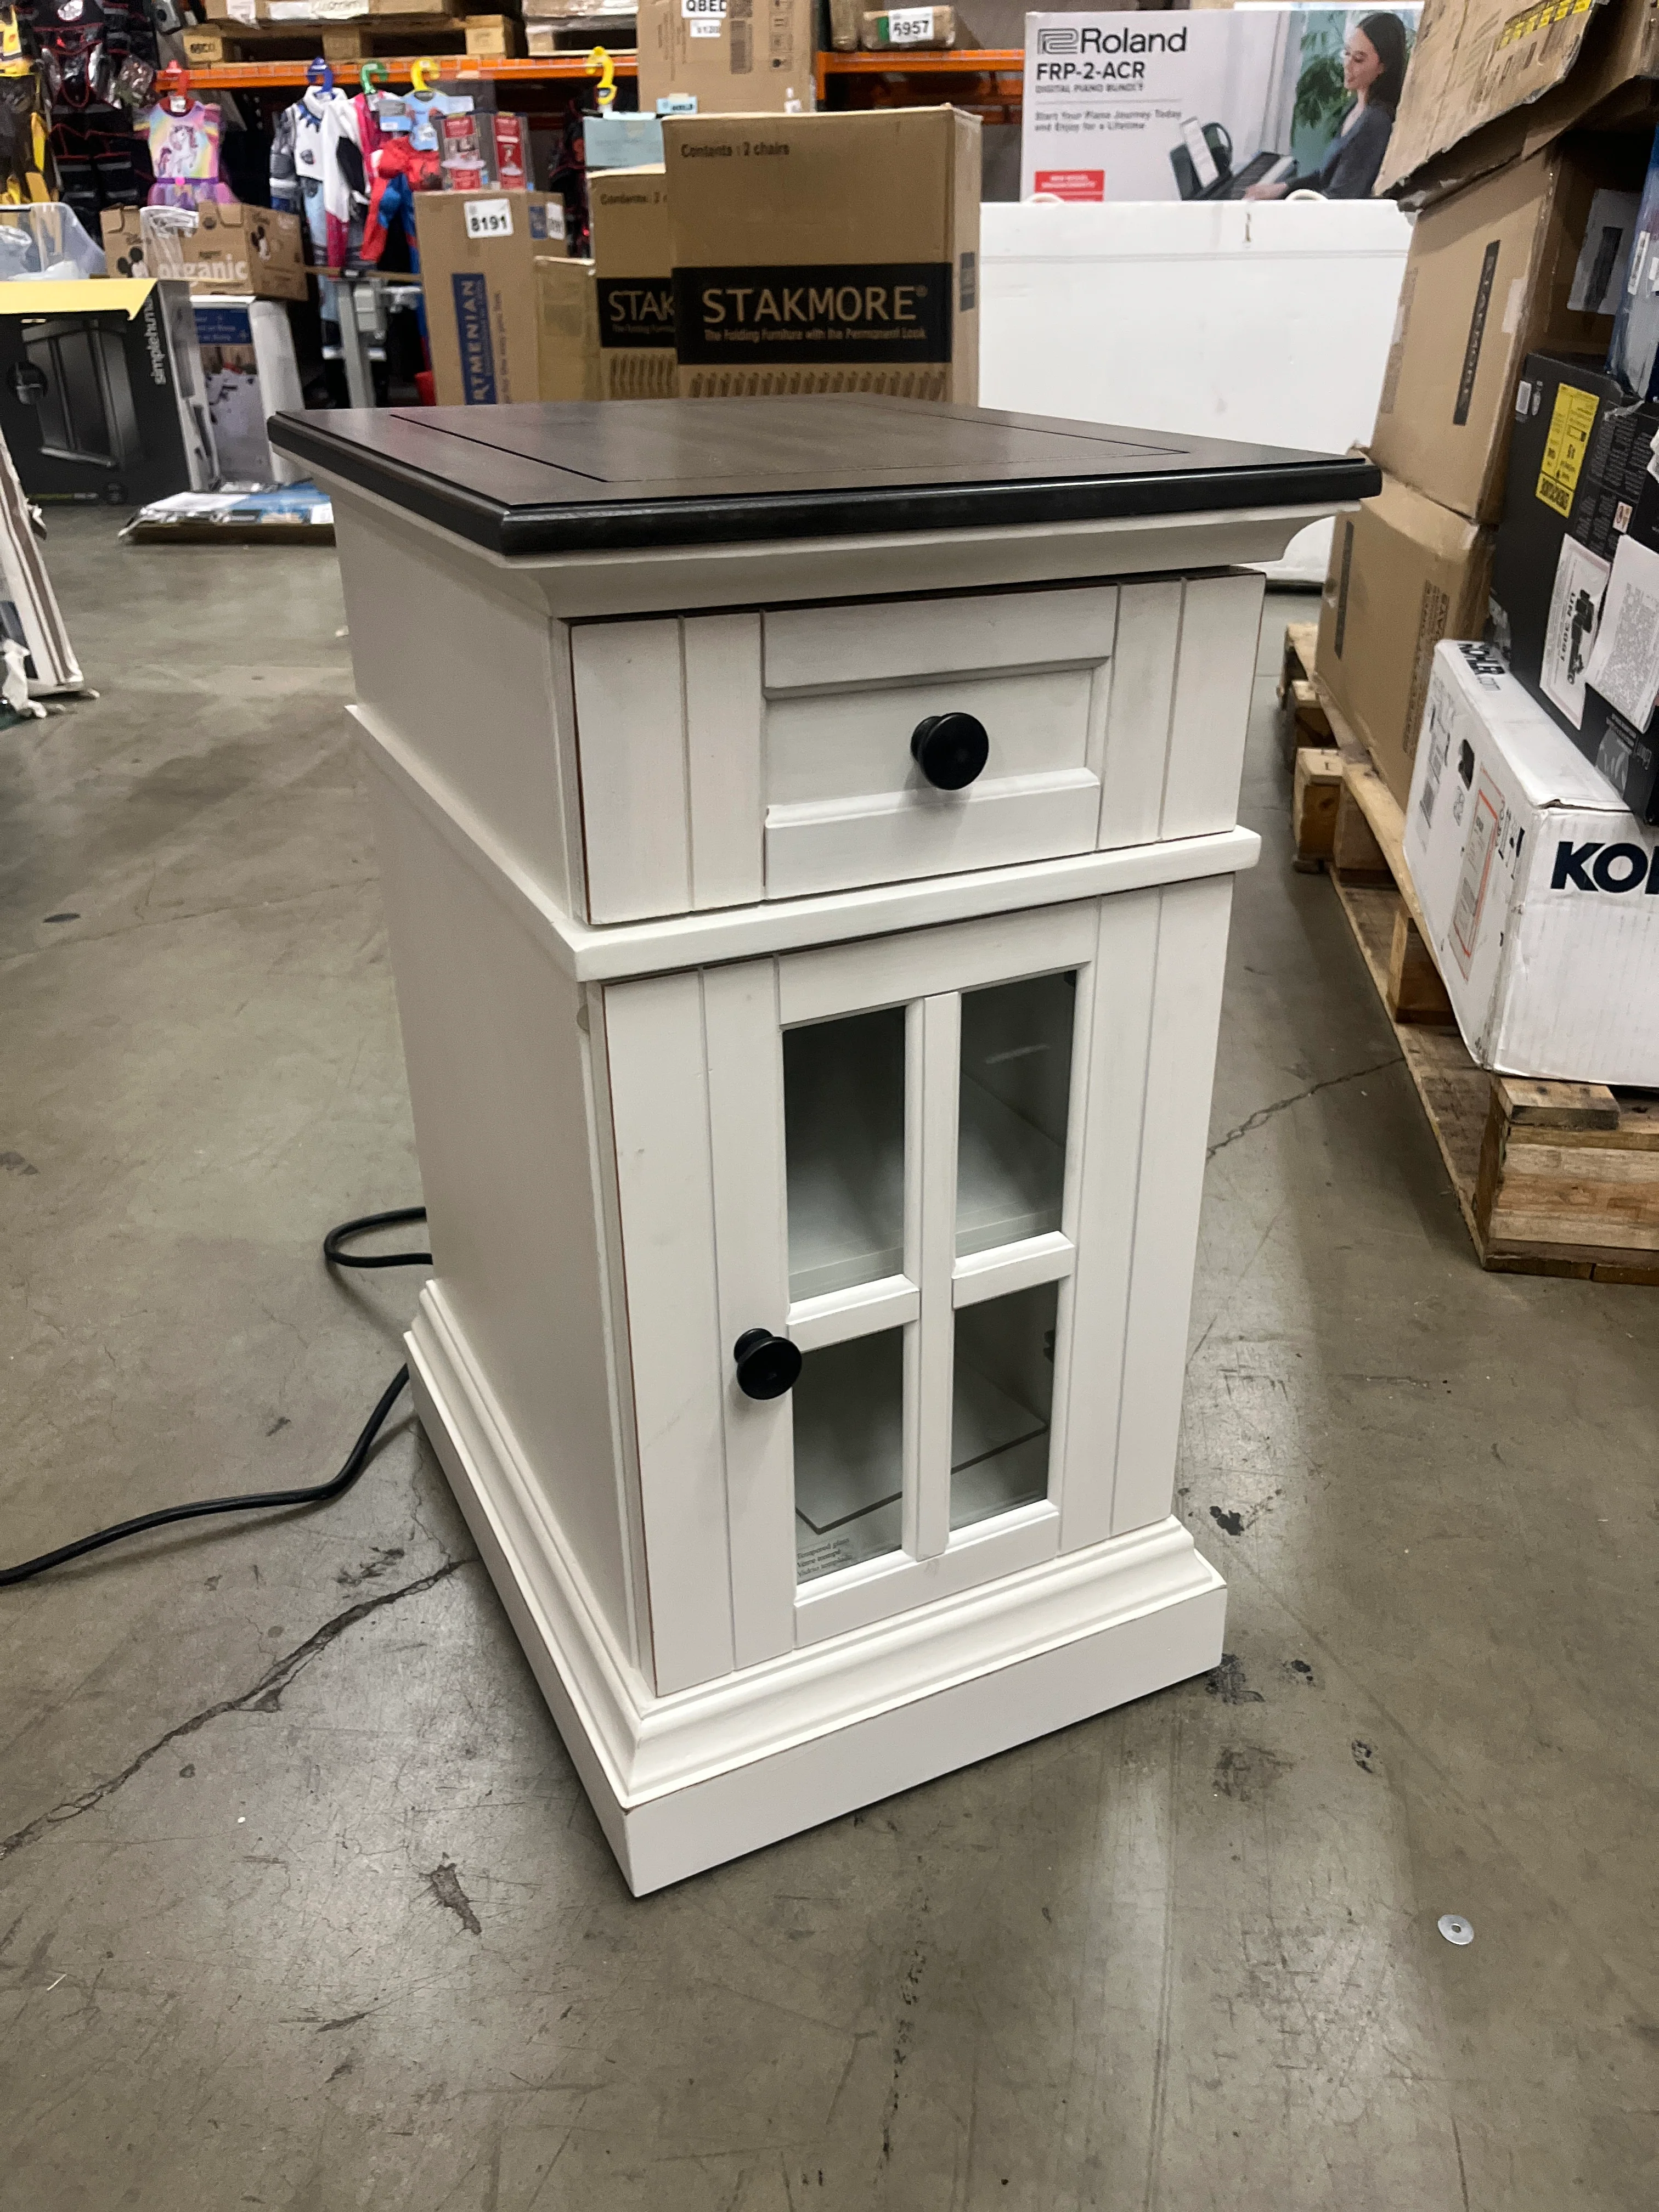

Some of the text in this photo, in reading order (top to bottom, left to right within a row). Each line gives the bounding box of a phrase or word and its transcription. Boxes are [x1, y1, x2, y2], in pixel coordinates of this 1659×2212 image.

[1081, 27, 1187, 54] Roland
[1036, 61, 1145, 80] FRP-2-ACR
[681, 144, 732, 157] Contents
[471, 215, 508, 232] 8191
[702, 285, 917, 324] STAKMORE
[1550, 840, 1659, 895] KO
